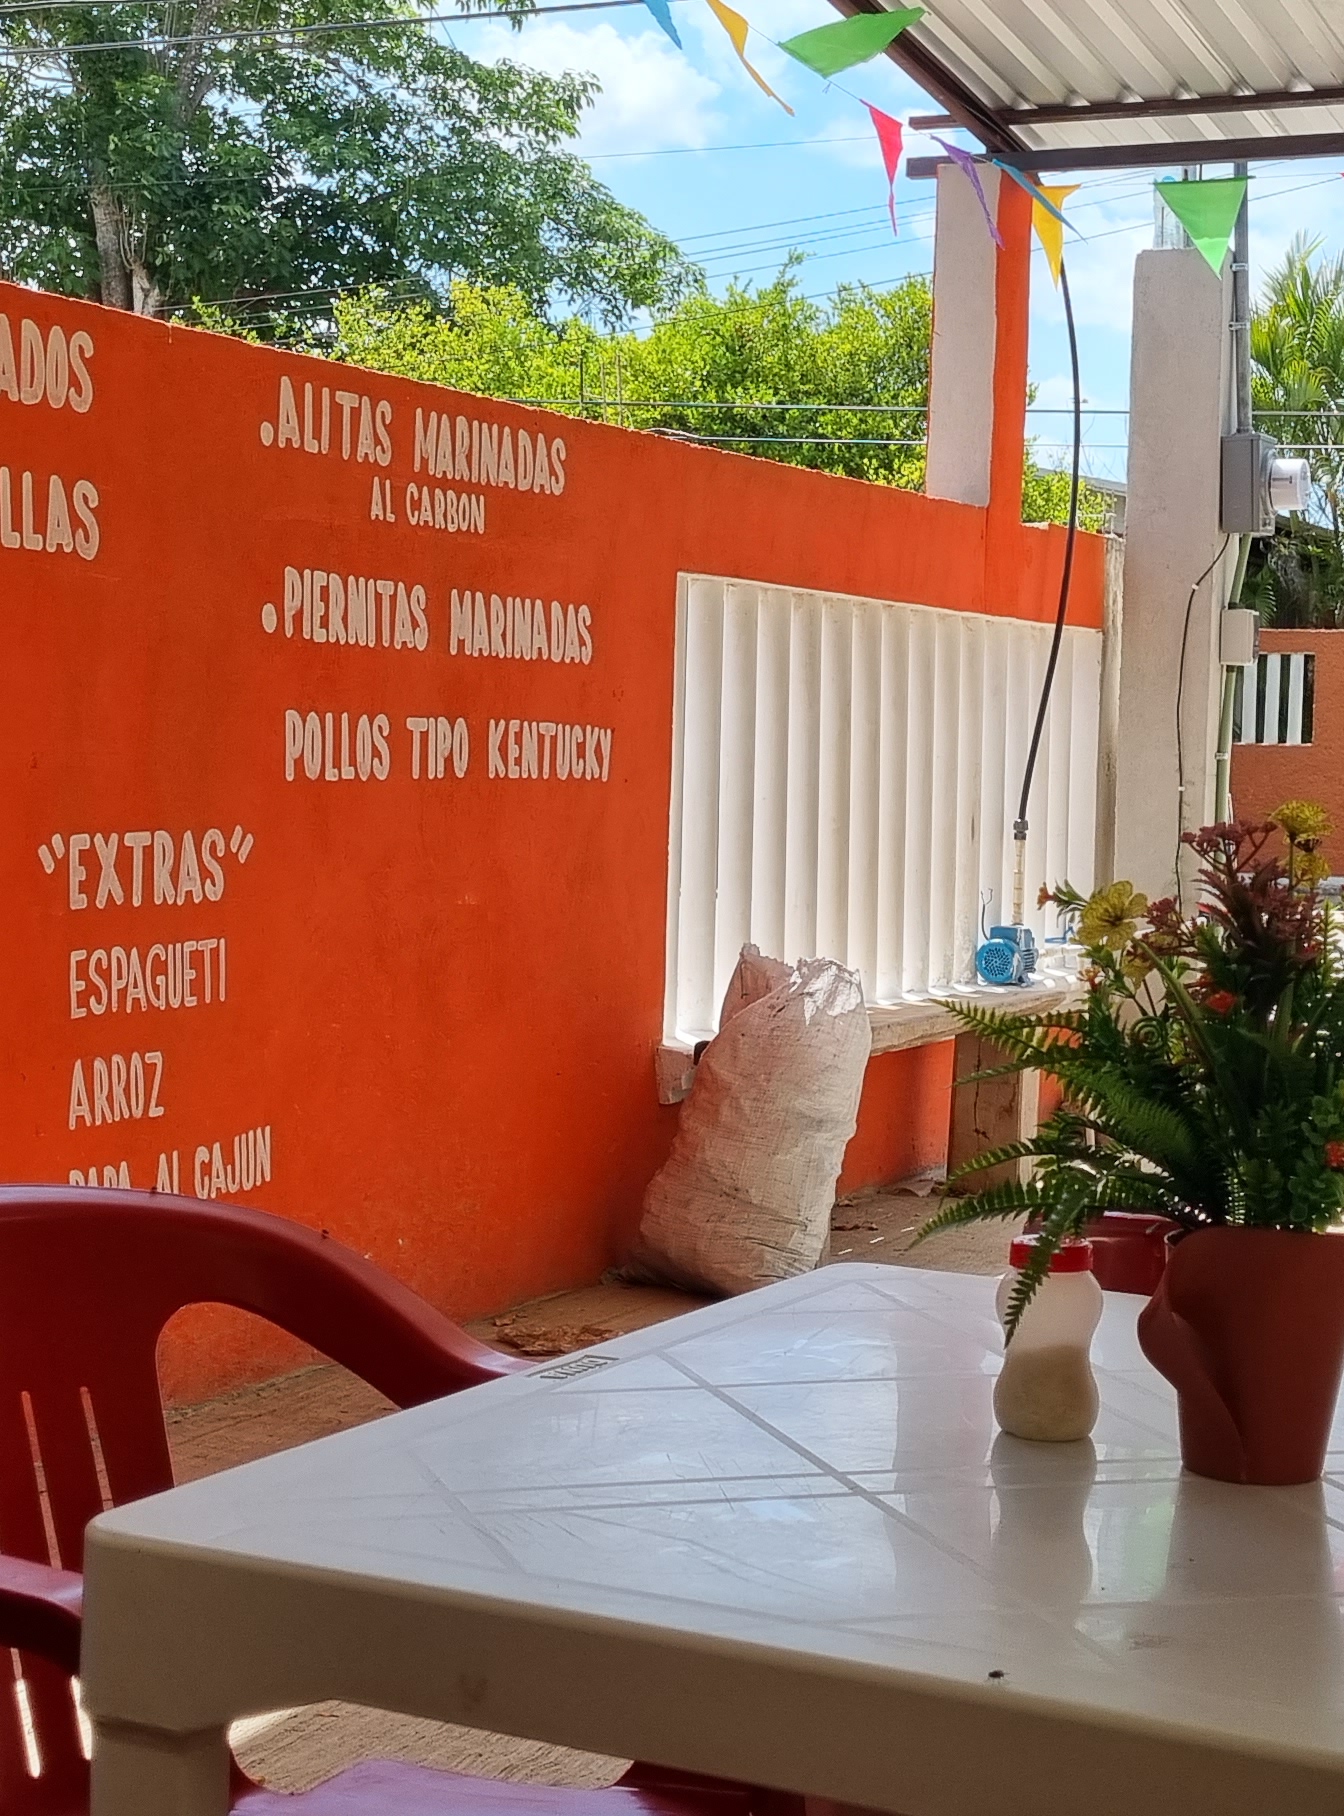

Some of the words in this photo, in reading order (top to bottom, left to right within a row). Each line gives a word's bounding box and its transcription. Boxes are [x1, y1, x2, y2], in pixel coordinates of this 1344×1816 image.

[413, 406, 567, 496] MARINADAS
[370, 476, 396, 523] AL
[406, 481, 487, 535] CARBON
[450, 588, 594, 666] MARINADAS
[285, 709, 391, 782] POLLOS
[406, 716, 469, 780] TIPO
[488, 718, 613, 782] KENTUCKY
[69, 937, 226, 1019] ESPAGUETI
[68, 1051, 165, 1130] ARROZ
[194, 1125, 271, 1200] CAJUN
